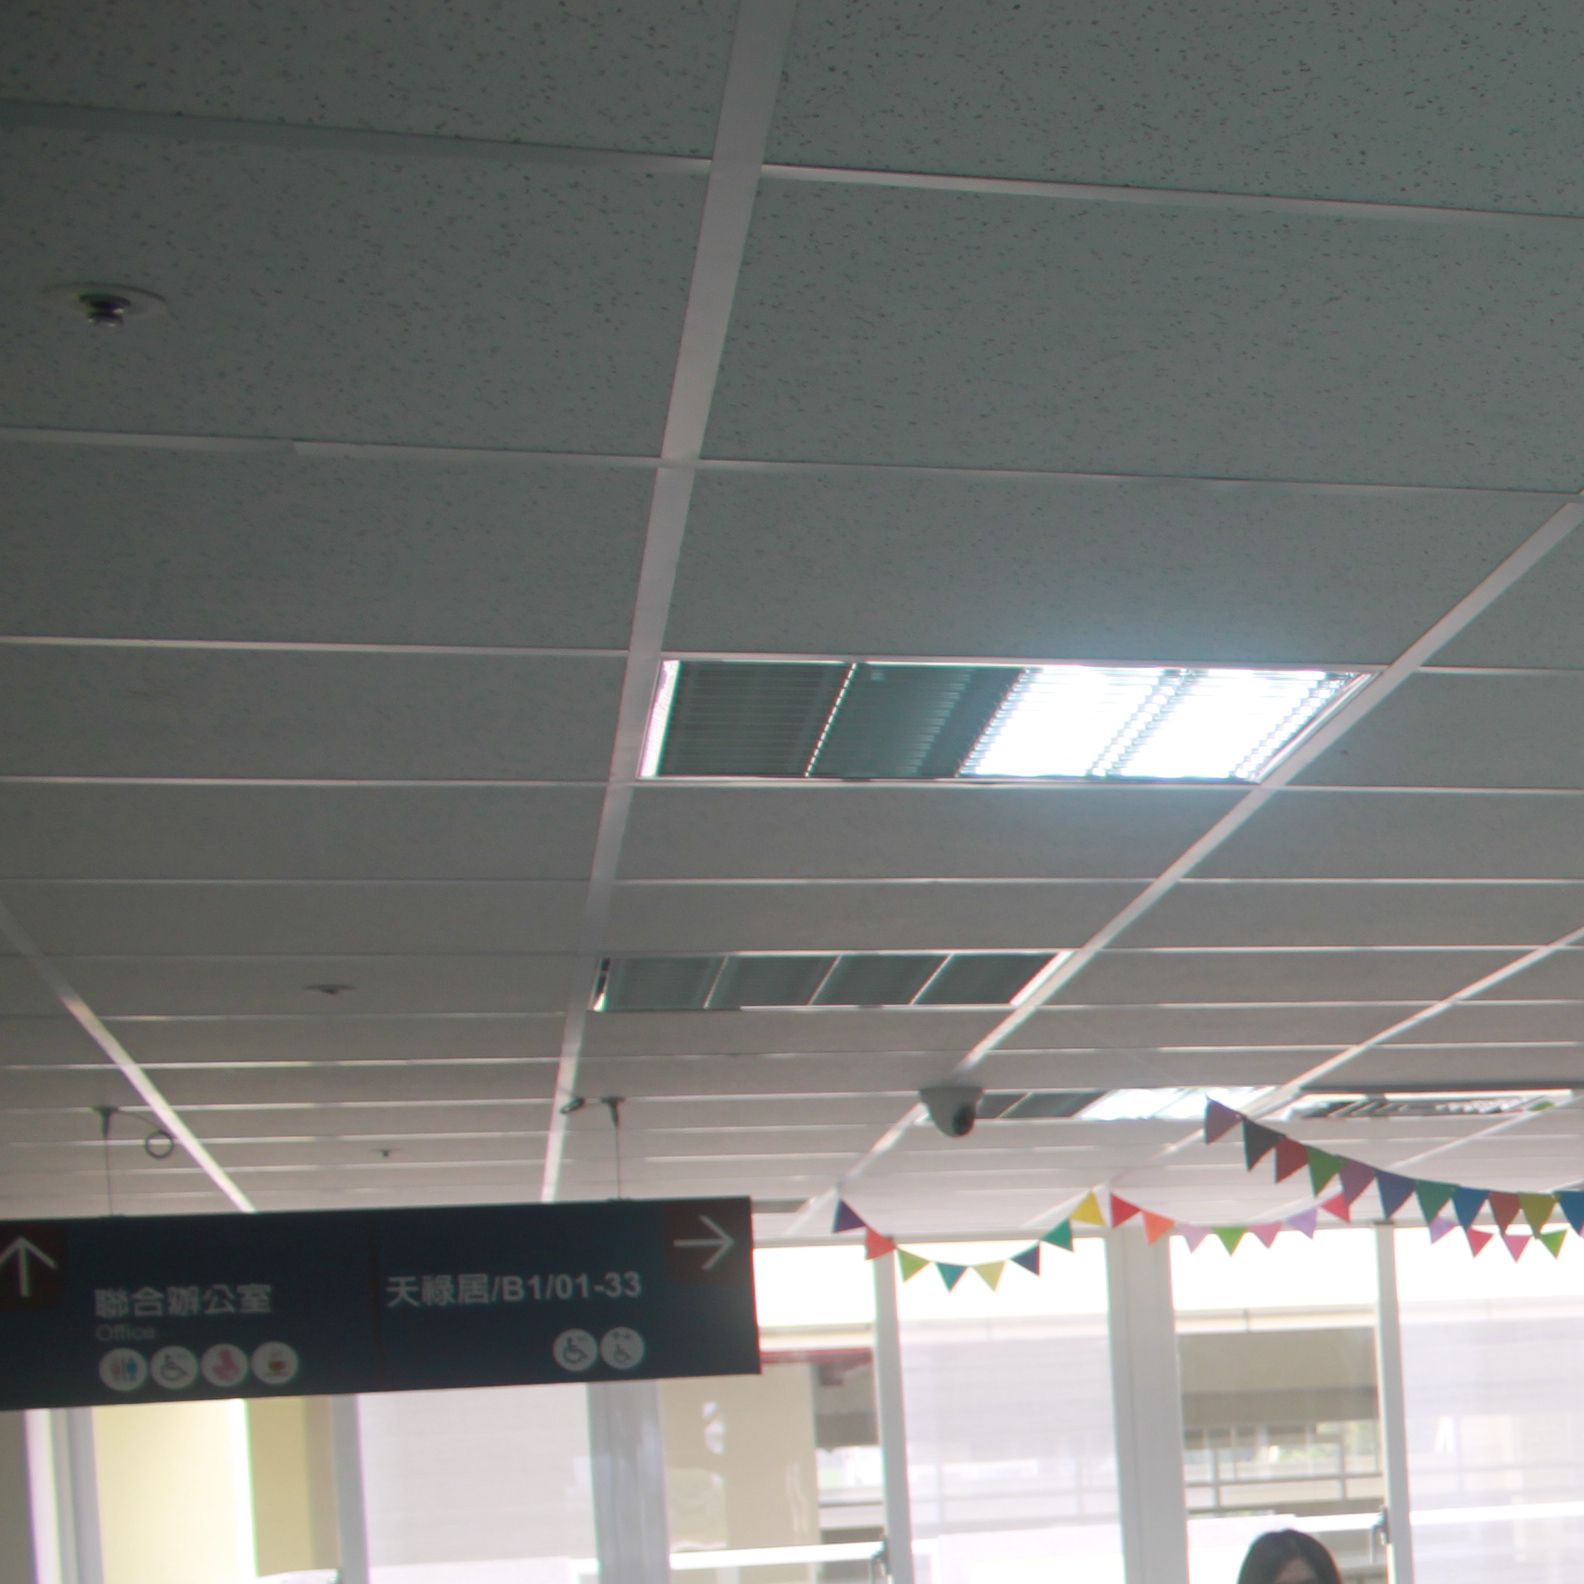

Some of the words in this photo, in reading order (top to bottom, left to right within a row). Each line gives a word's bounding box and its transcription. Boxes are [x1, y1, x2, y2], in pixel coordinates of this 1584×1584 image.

[94, 1283, 272, 1318] 聯合辦公室
[386, 1271, 642, 1308] 天祿居/B1/01-33
[95, 1323, 156, 1341] Office
